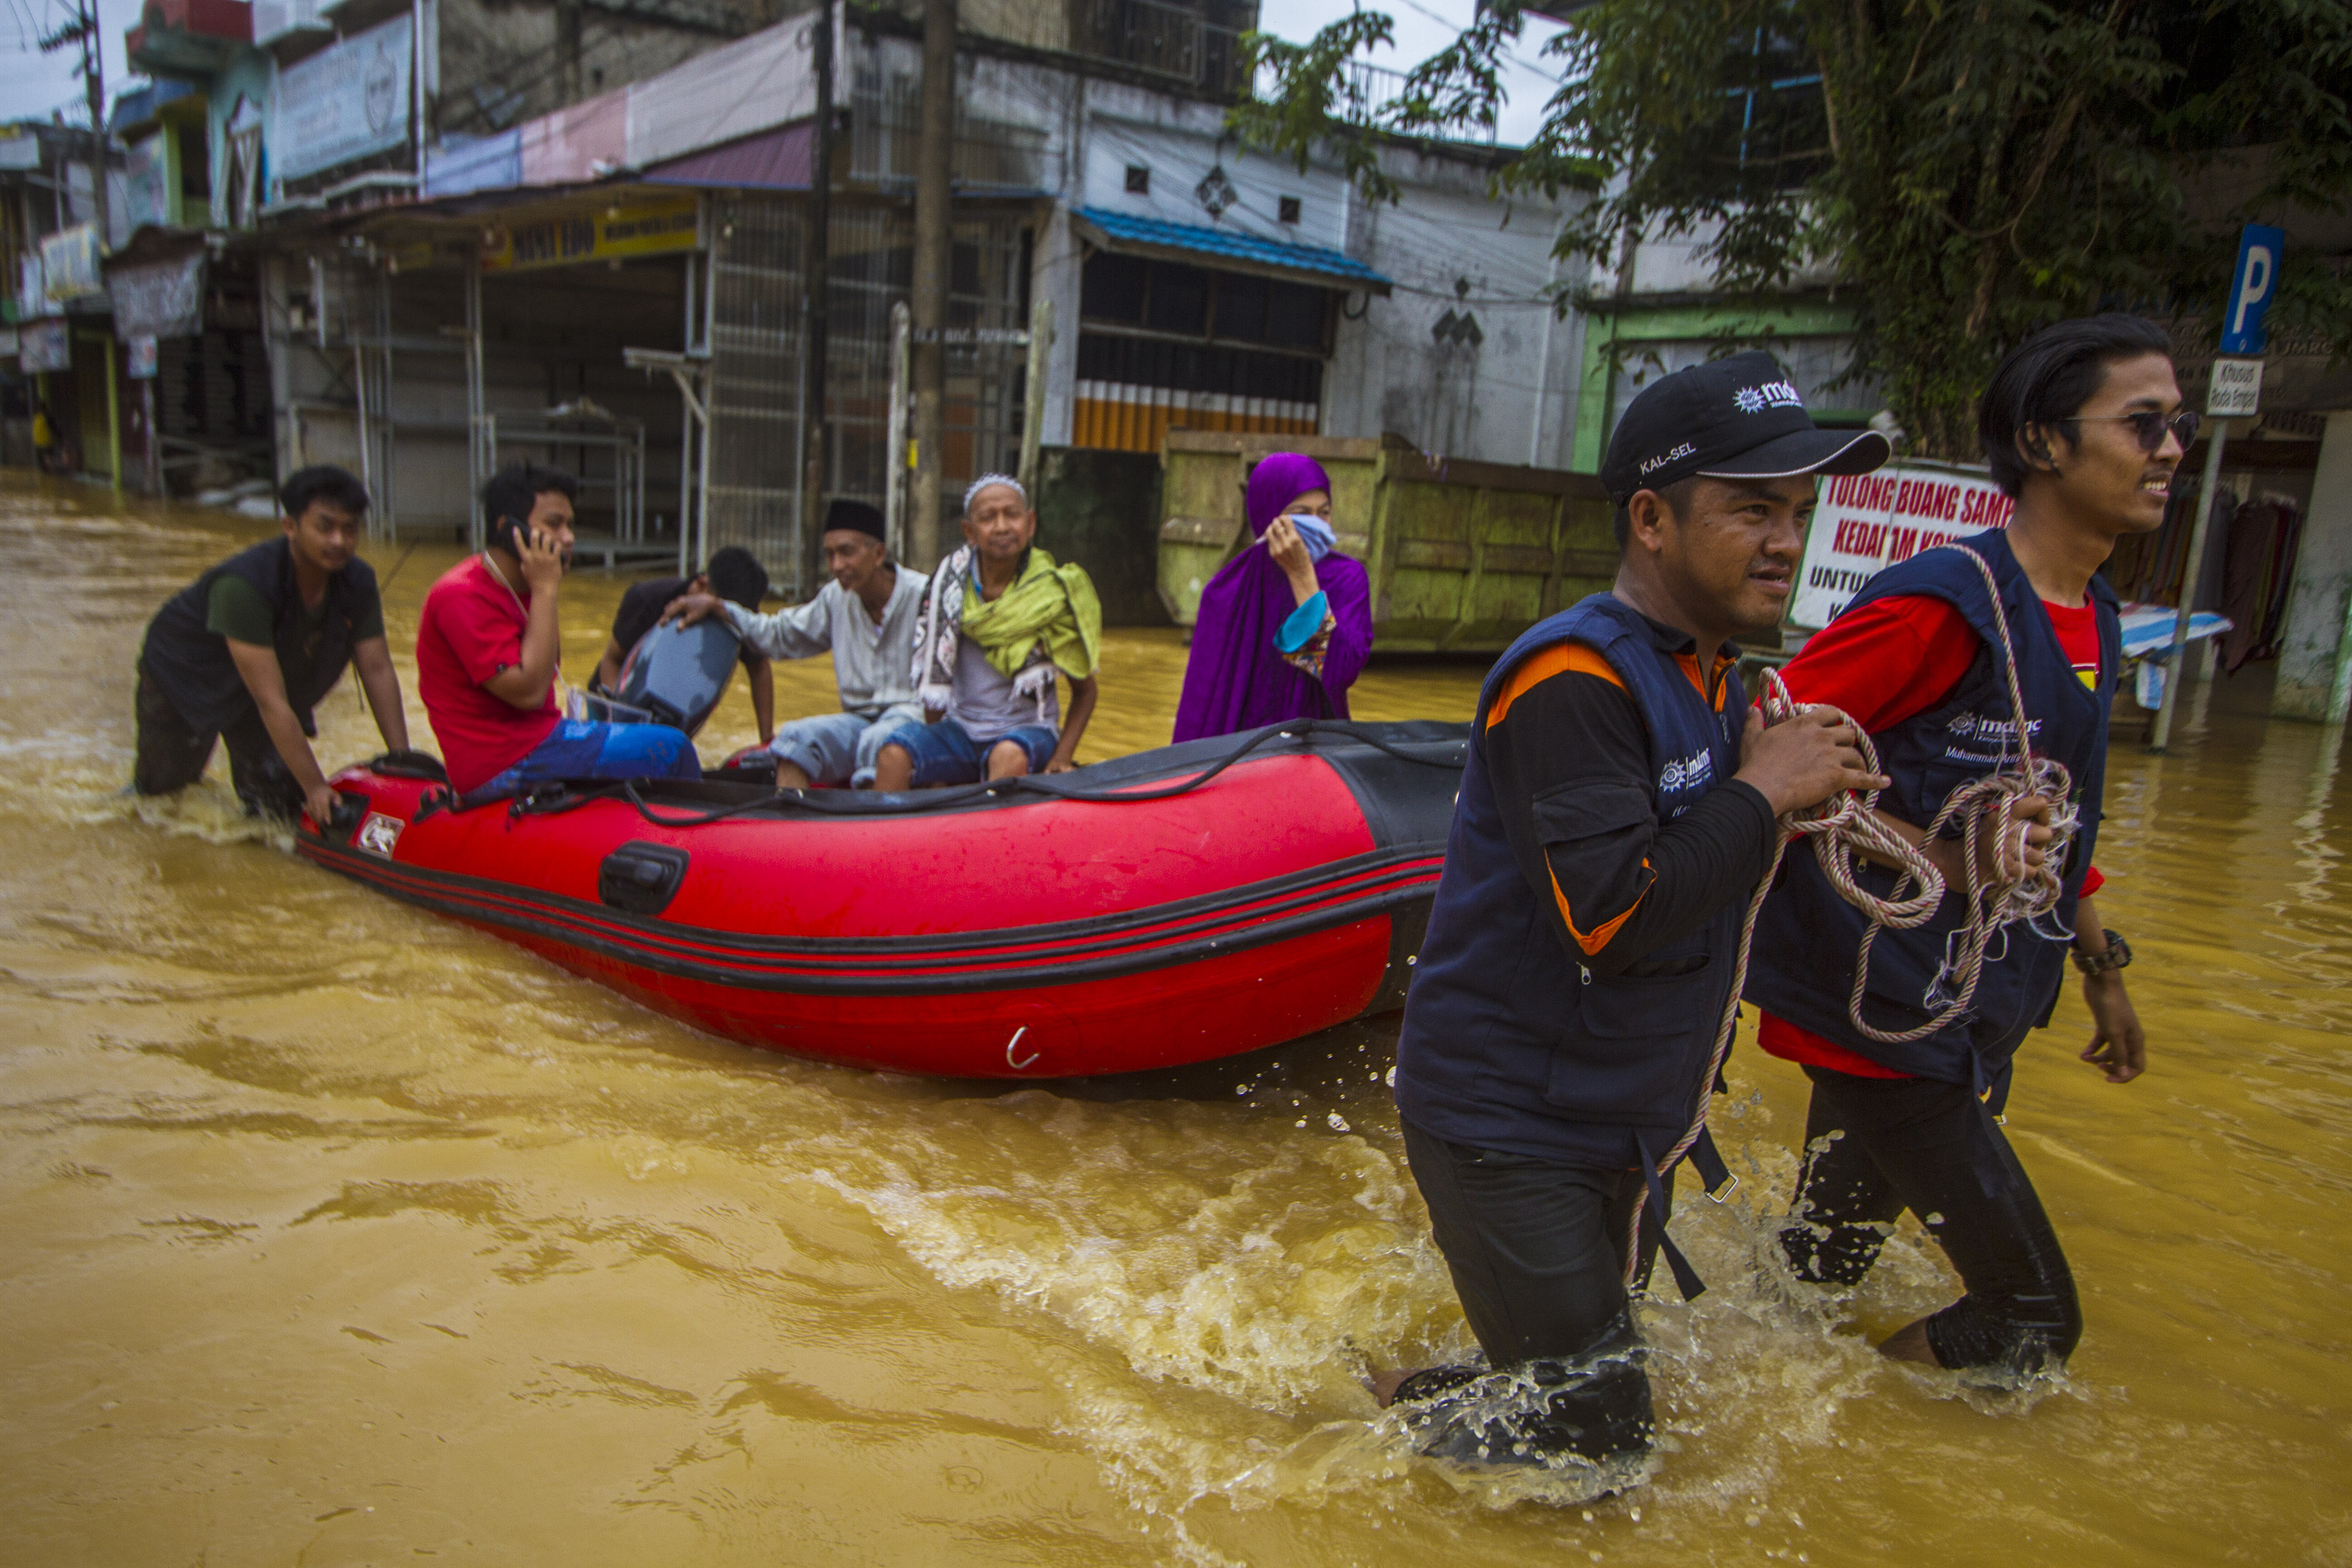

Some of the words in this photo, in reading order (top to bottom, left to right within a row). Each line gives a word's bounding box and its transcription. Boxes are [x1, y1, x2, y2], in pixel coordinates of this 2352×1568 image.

[2233, 245, 2272, 333] P
[1640, 442, 1697, 476] KAL-SEL
[1895, 479, 1962, 522] BUANG
[1945, 745, 2000, 763] Muhammad
